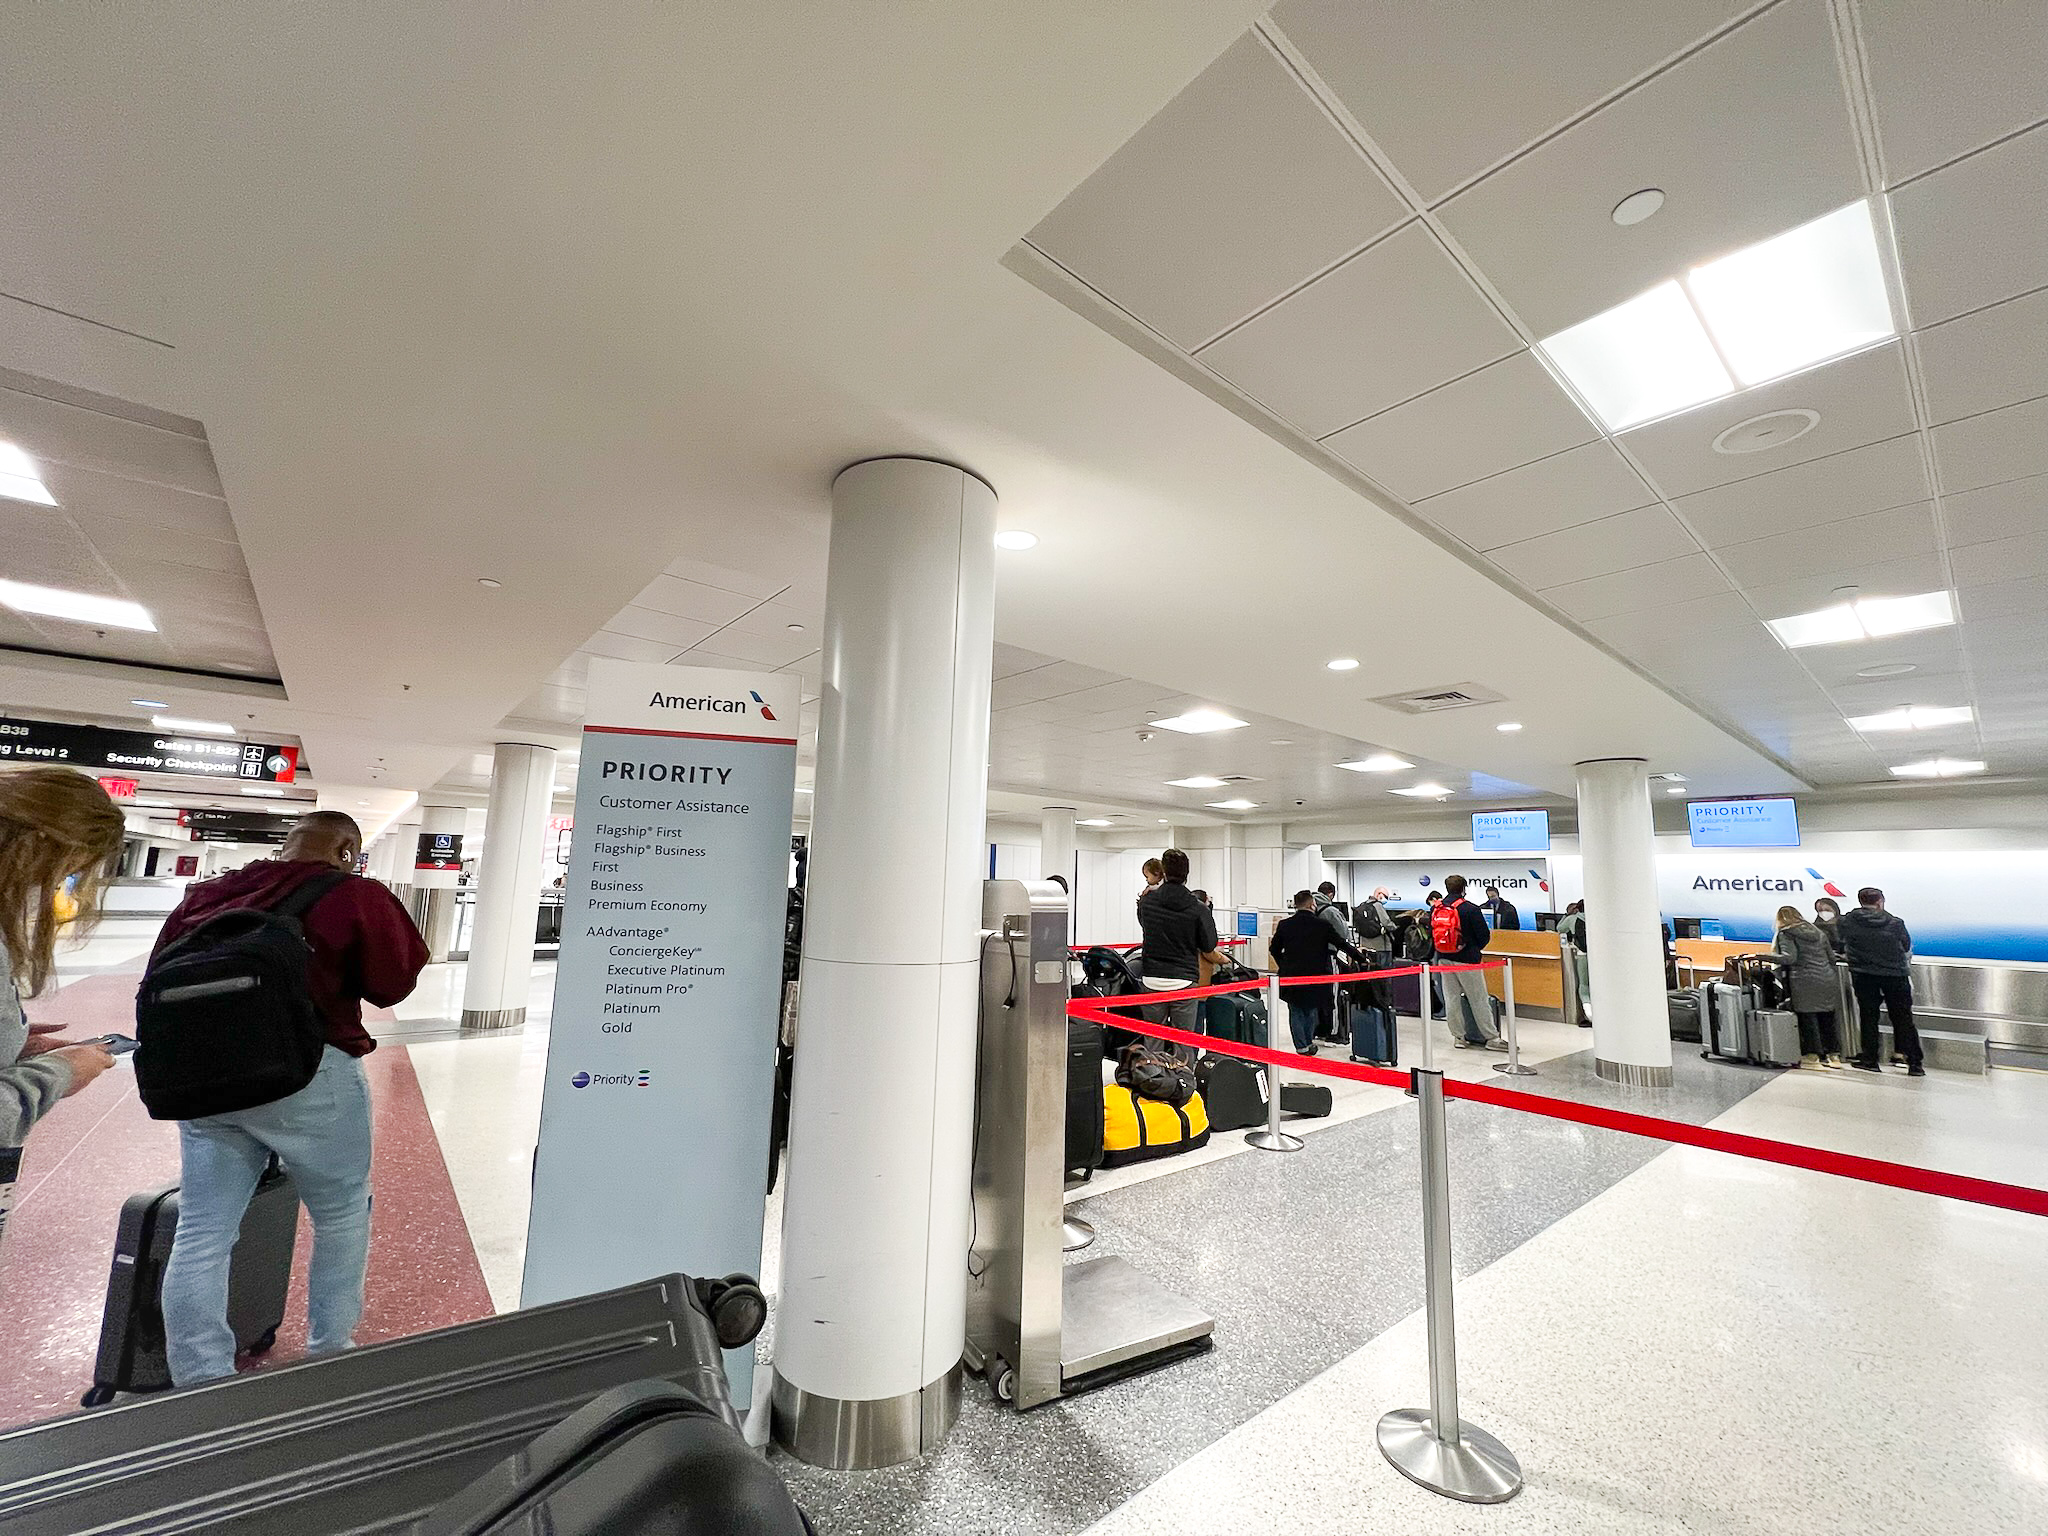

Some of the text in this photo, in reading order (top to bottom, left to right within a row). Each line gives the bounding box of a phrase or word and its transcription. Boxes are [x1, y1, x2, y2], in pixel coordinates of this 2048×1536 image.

[649, 692, 746, 714] American
[15, 744, 56, 757] Level
[58, 748, 69, 758] 2
[153, 739, 240, 756] Gates B1-B22
[106, 753, 238, 773] Security Checkpoint
[602, 761, 732, 785] PRIORITY
[599, 795, 749, 814] Customer Assistance
[1695, 806, 1764, 816] PRIORITY
[1477, 816, 1526, 825] PRIORITY
[656, 827, 682, 838] First
[655, 845, 706, 857] Business
[592, 861, 619, 872] First
[590, 880, 644, 892] Business
[1692, 875, 1803, 892] American
[588, 899, 707, 914] Premium Economy
[607, 964, 725, 975] Executive Platinum
[605, 984, 662, 994] Platinum
[603, 1003, 661, 1014] Platinum
[601, 1022, 632, 1033] Gold
[593, 1074, 635, 1086] Priority
